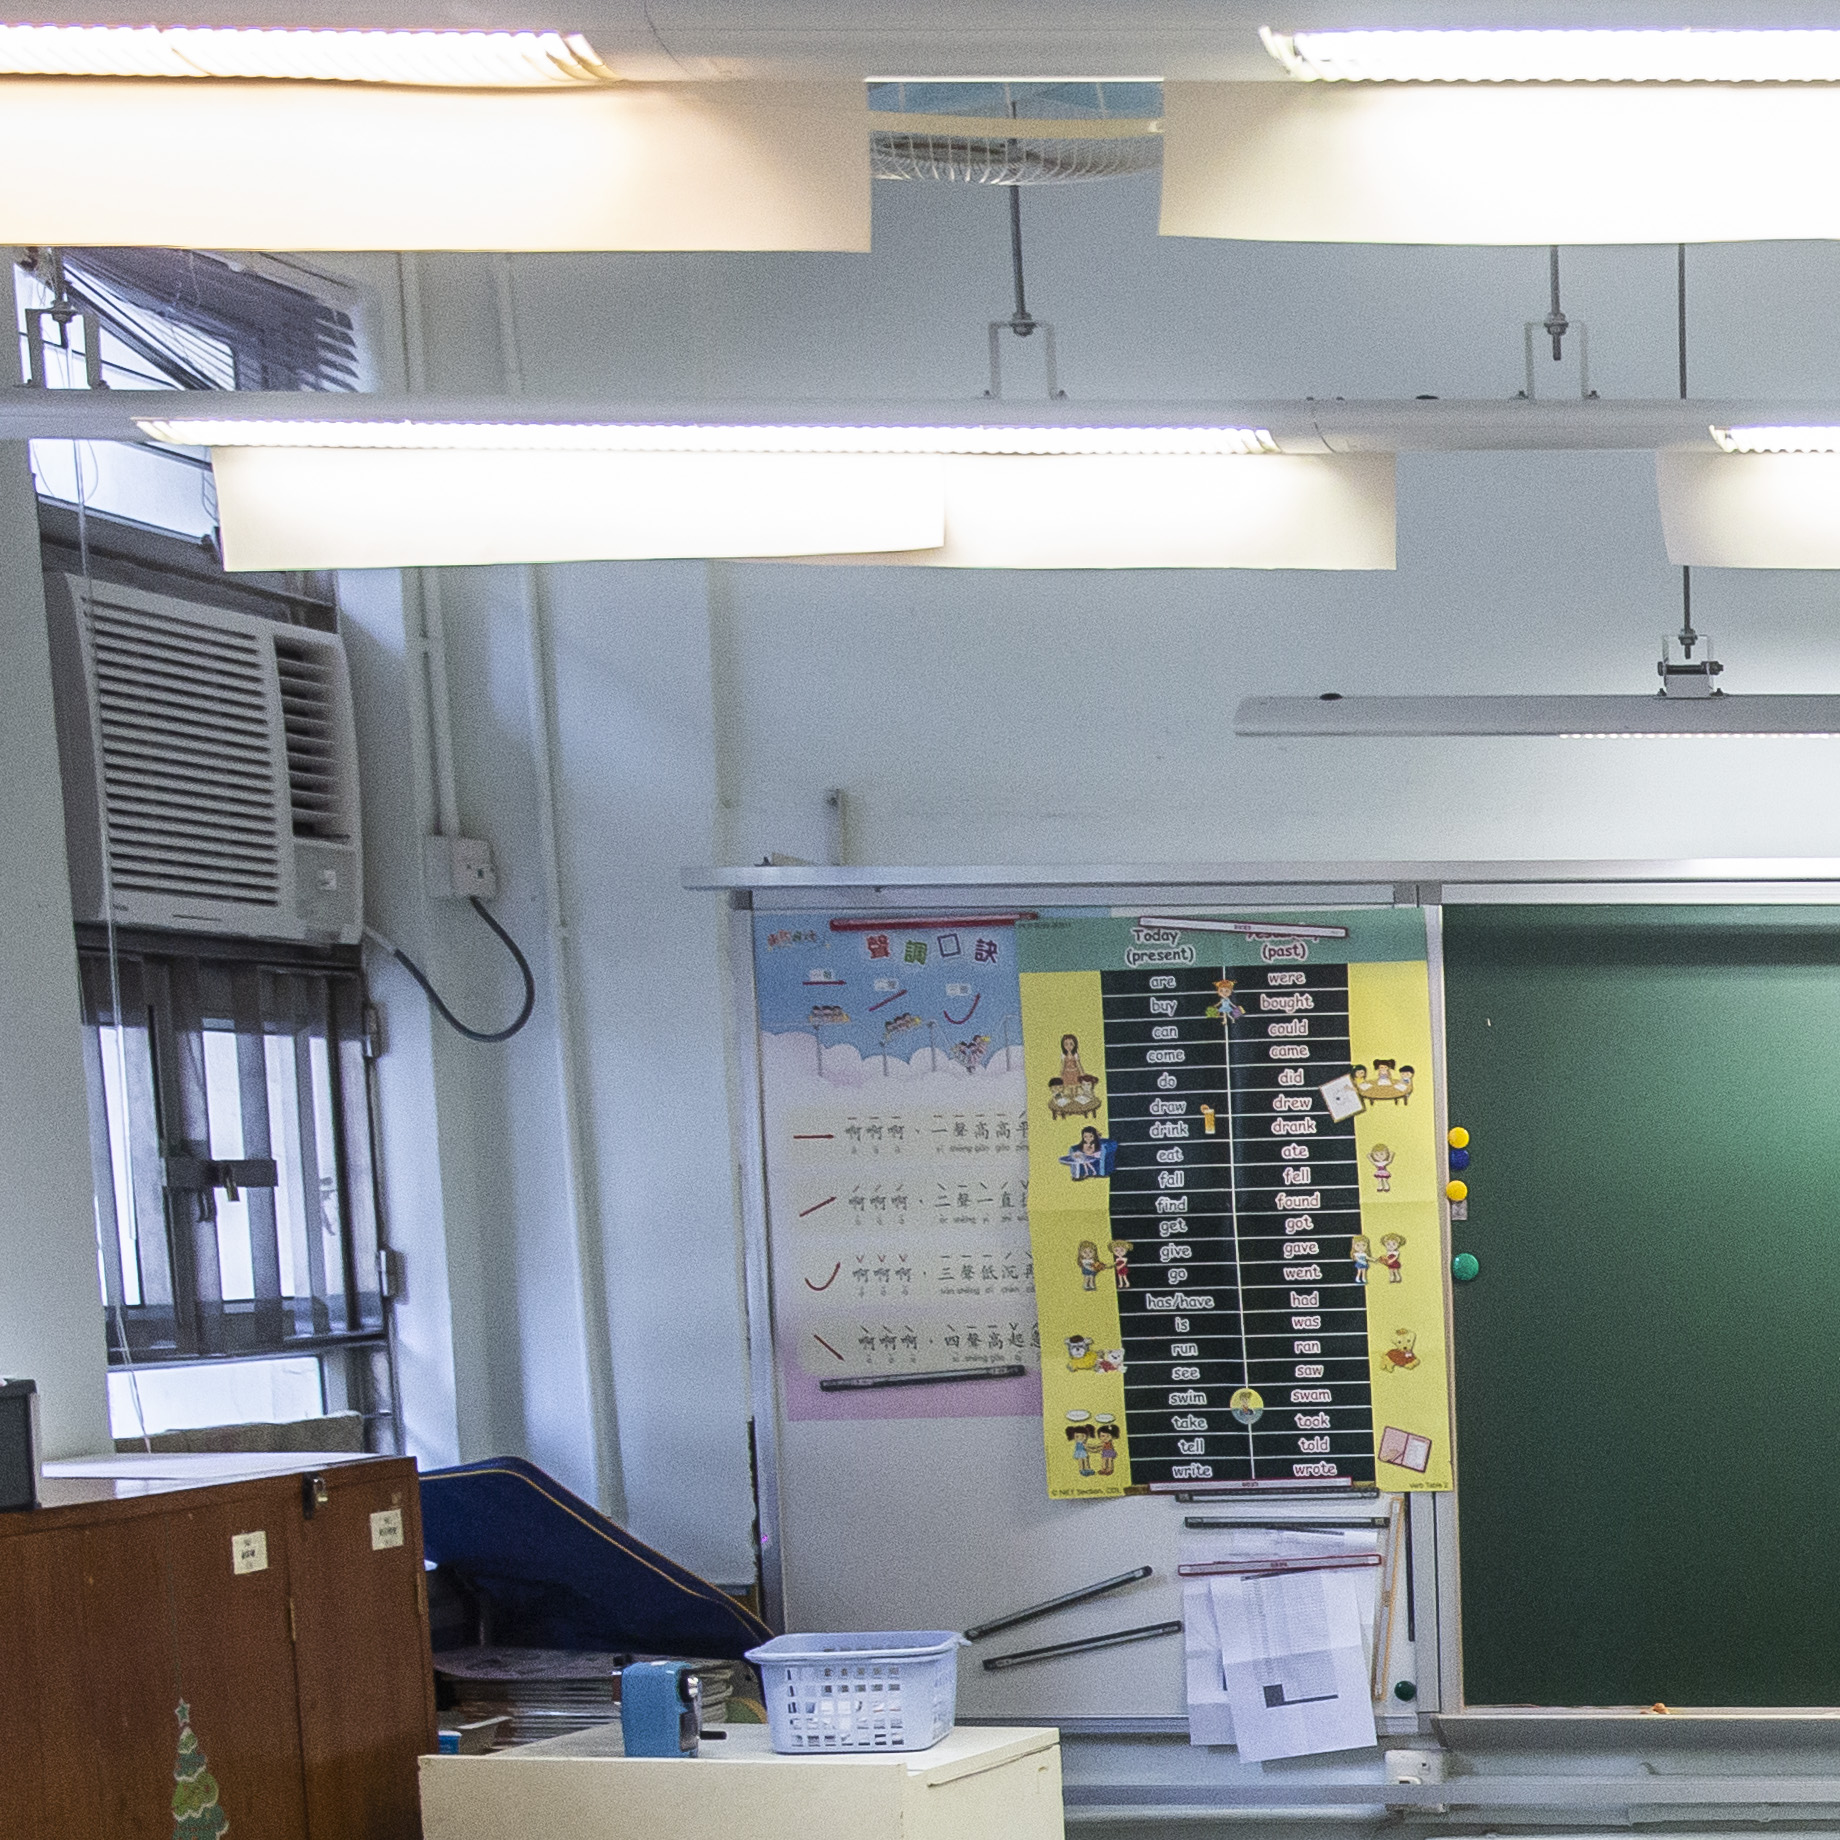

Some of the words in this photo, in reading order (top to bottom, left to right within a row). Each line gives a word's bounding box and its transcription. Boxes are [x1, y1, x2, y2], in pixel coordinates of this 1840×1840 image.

[1132, 928, 1179, 945] Today
[866, 933, 998, 965] 聲調口訣
[1126, 947, 1195, 966] (present)
[1262, 943, 1308, 961] (past)
[1150, 976, 1176, 988] are
[1268, 971, 1306, 985] were
[1150, 998, 1177, 1014] buy
[1260, 994, 1313, 1013] bought
[1152, 1025, 1178, 1040] can
[1268, 1020, 1308, 1036] could
[1147, 1049, 1185, 1063] come
[1269, 1044, 1310, 1058] came
[1157, 1073, 1177, 1089] do
[1278, 1068, 1304, 1085] did
[1150, 1099, 1187, 1114] draw
[1273, 1094, 1312, 1110] drew
[1150, 1121, 1189, 1138] drink
[1271, 1117, 1316, 1134] drank
[1157, 1146, 1184, 1162] eat
[1281, 1143, 1309, 1159] ate
[1158, 1170, 1184, 1188] fall
[1283, 1167, 1311, 1184] fell
[1155, 1196, 1187, 1213] find
[1275, 1192, 1321, 1209] found
[1159, 1218, 1188, 1236] get
[1285, 1215, 1314, 1234] got
[1160, 1244, 1192, 1262] give
[1283, 1241, 1319, 1258] gave
[1168, 1268, 1187, 1284] go
[1283, 1265, 1322, 1280] went
[1146, 1293, 1215, 1309] has/have
[1290, 1291, 1319, 1307] had
[1175, 1316, 1189, 1332] is
[1291, 1316, 1321, 1329] was
[1171, 1343, 1198, 1356] run
[1294, 1341, 1321, 1354] ran
[1172, 1367, 1200, 1379] see
[1295, 1365, 1324, 1377] saw
[1169, 1391, 1207, 1406] swim
[1291, 1388, 1331, 1402] swam
[1171, 1415, 1208, 1432] take
[1295, 1412, 1330, 1429] took
[1178, 1438, 1205, 1455] tell
[1299, 1437, 1330, 1453] told
[1172, 1462, 1212, 1479] write
[1293, 1461, 1337, 1477] wrote
